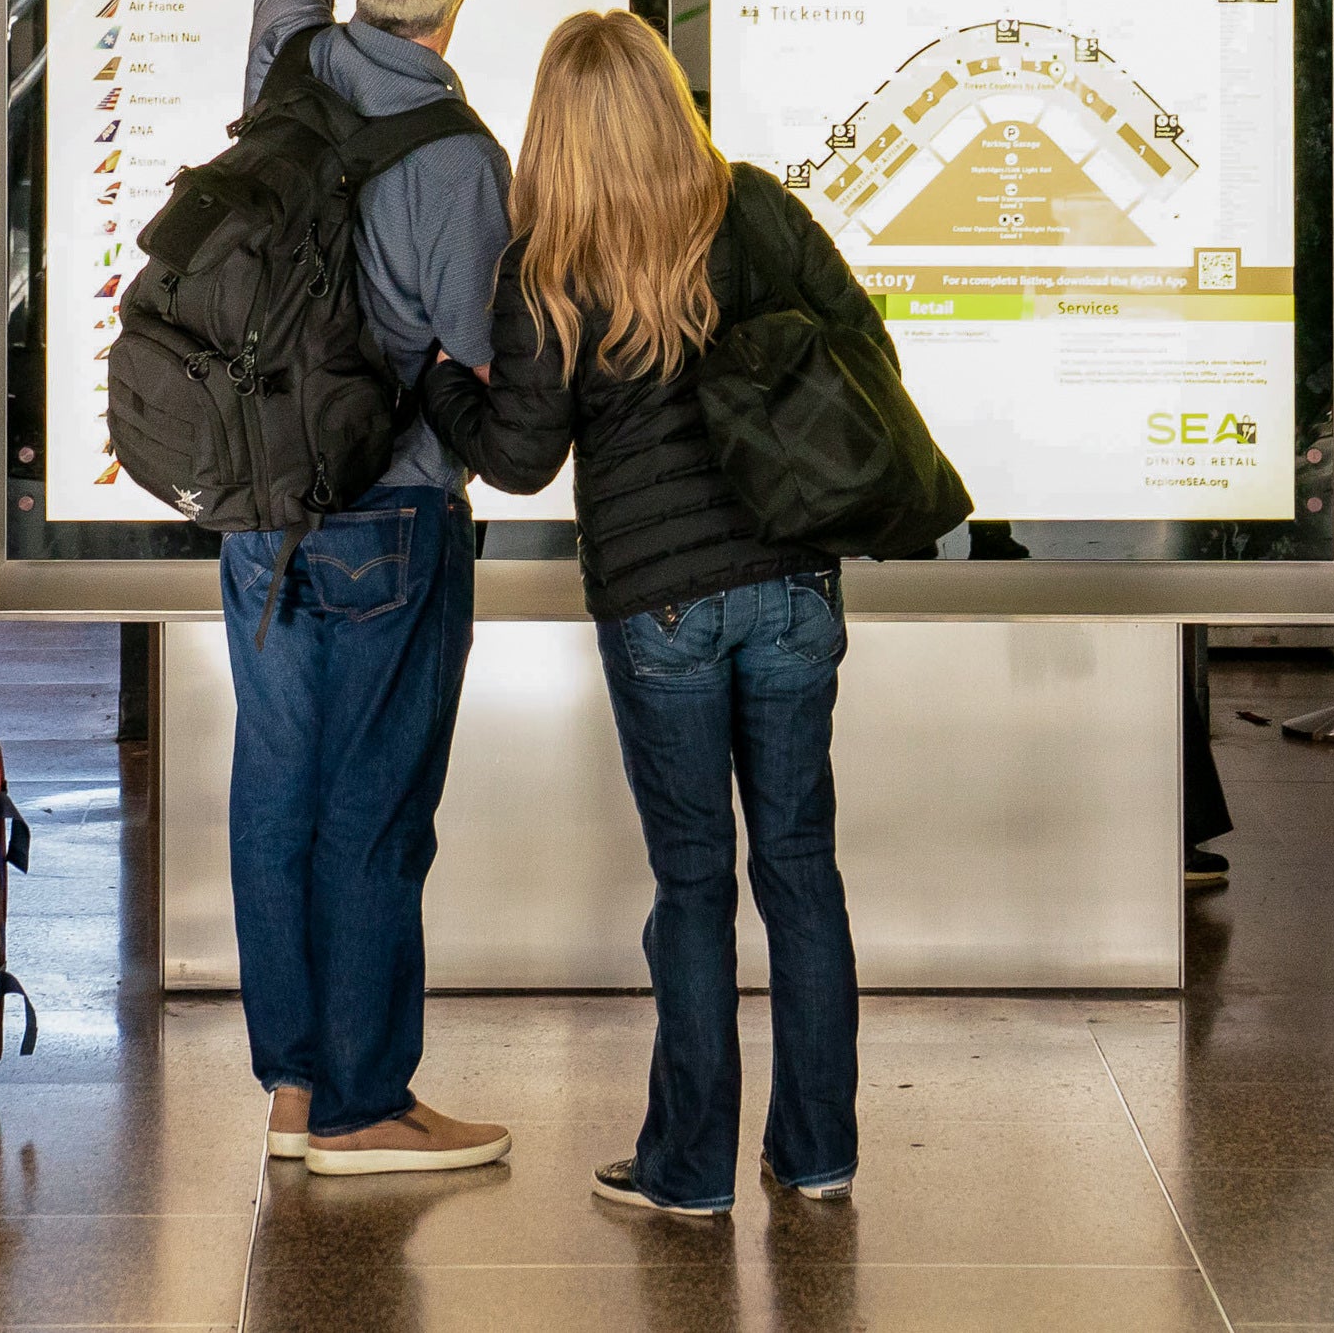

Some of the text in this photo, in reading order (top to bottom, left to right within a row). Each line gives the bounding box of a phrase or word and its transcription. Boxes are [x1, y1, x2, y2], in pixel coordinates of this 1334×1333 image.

[129, 2, 184, 11] Air France
[771, 6, 865, 22] Ticketing
[129, 33, 200, 42] Air Tahiti Nui
[130, 64, 154, 73] AMC
[130, 95, 180, 104] American
[130, 126, 154, 135] ANA
[943, 275, 958, 286] For
[961, 278, 967, 286] a
[969, 275, 1017, 288] complete
[910, 301, 954, 315] Retail
[1058, 301, 1119, 315] Services
[1147, 413, 1249, 444] SEA
[1212, 458, 1257, 466] RETAIL
[1145, 478, 1228, 488] ExploreSEA.org
